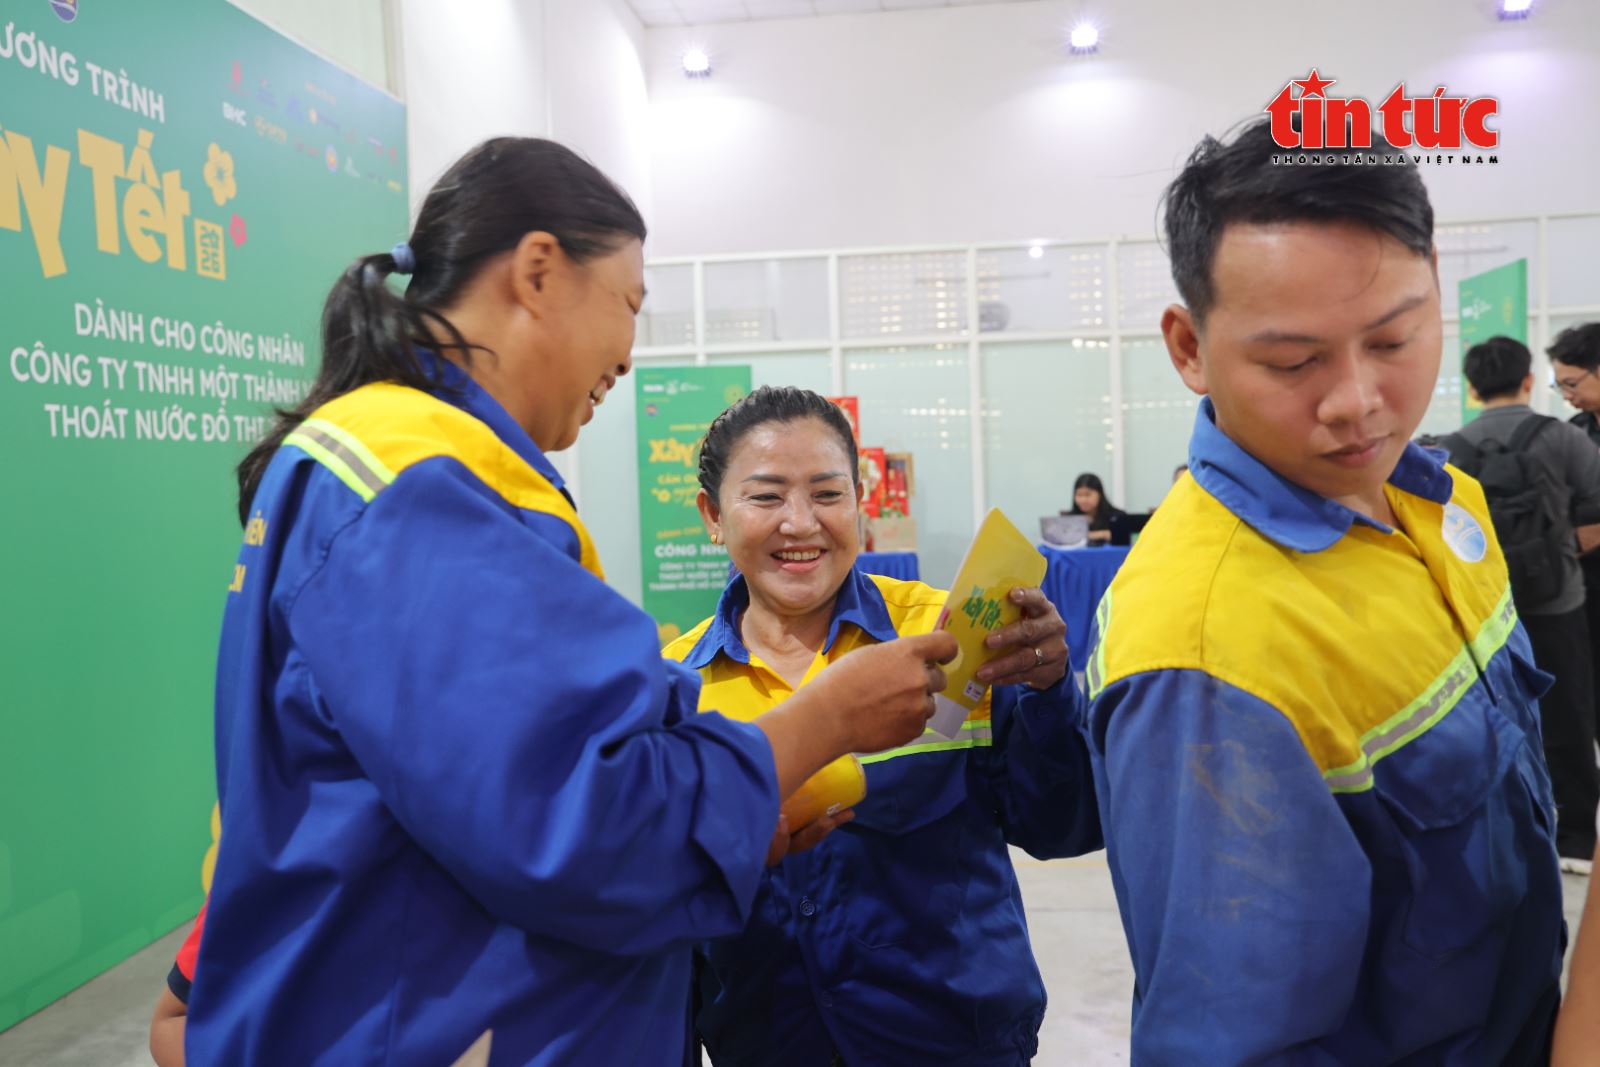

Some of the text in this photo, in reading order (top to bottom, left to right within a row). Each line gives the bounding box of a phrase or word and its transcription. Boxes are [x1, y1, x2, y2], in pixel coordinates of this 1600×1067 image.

[85, 61, 165, 124] TRÌNH
[77, 127, 191, 272] Tết
[74, 297, 304, 367] DÀNH CHO CÔNG NHÂN
[10, 340, 92, 387] CÔNG
[97, 356, 128, 390] TY
[133, 360, 194, 396] TNHH
[200, 364, 240, 406] MỘT
[243, 370, 299, 404] THÀNH
[44, 398, 128, 439] THOÁT
[135, 404, 198, 442] NƯỚC
[202, 407, 231, 442] ĐÔ
